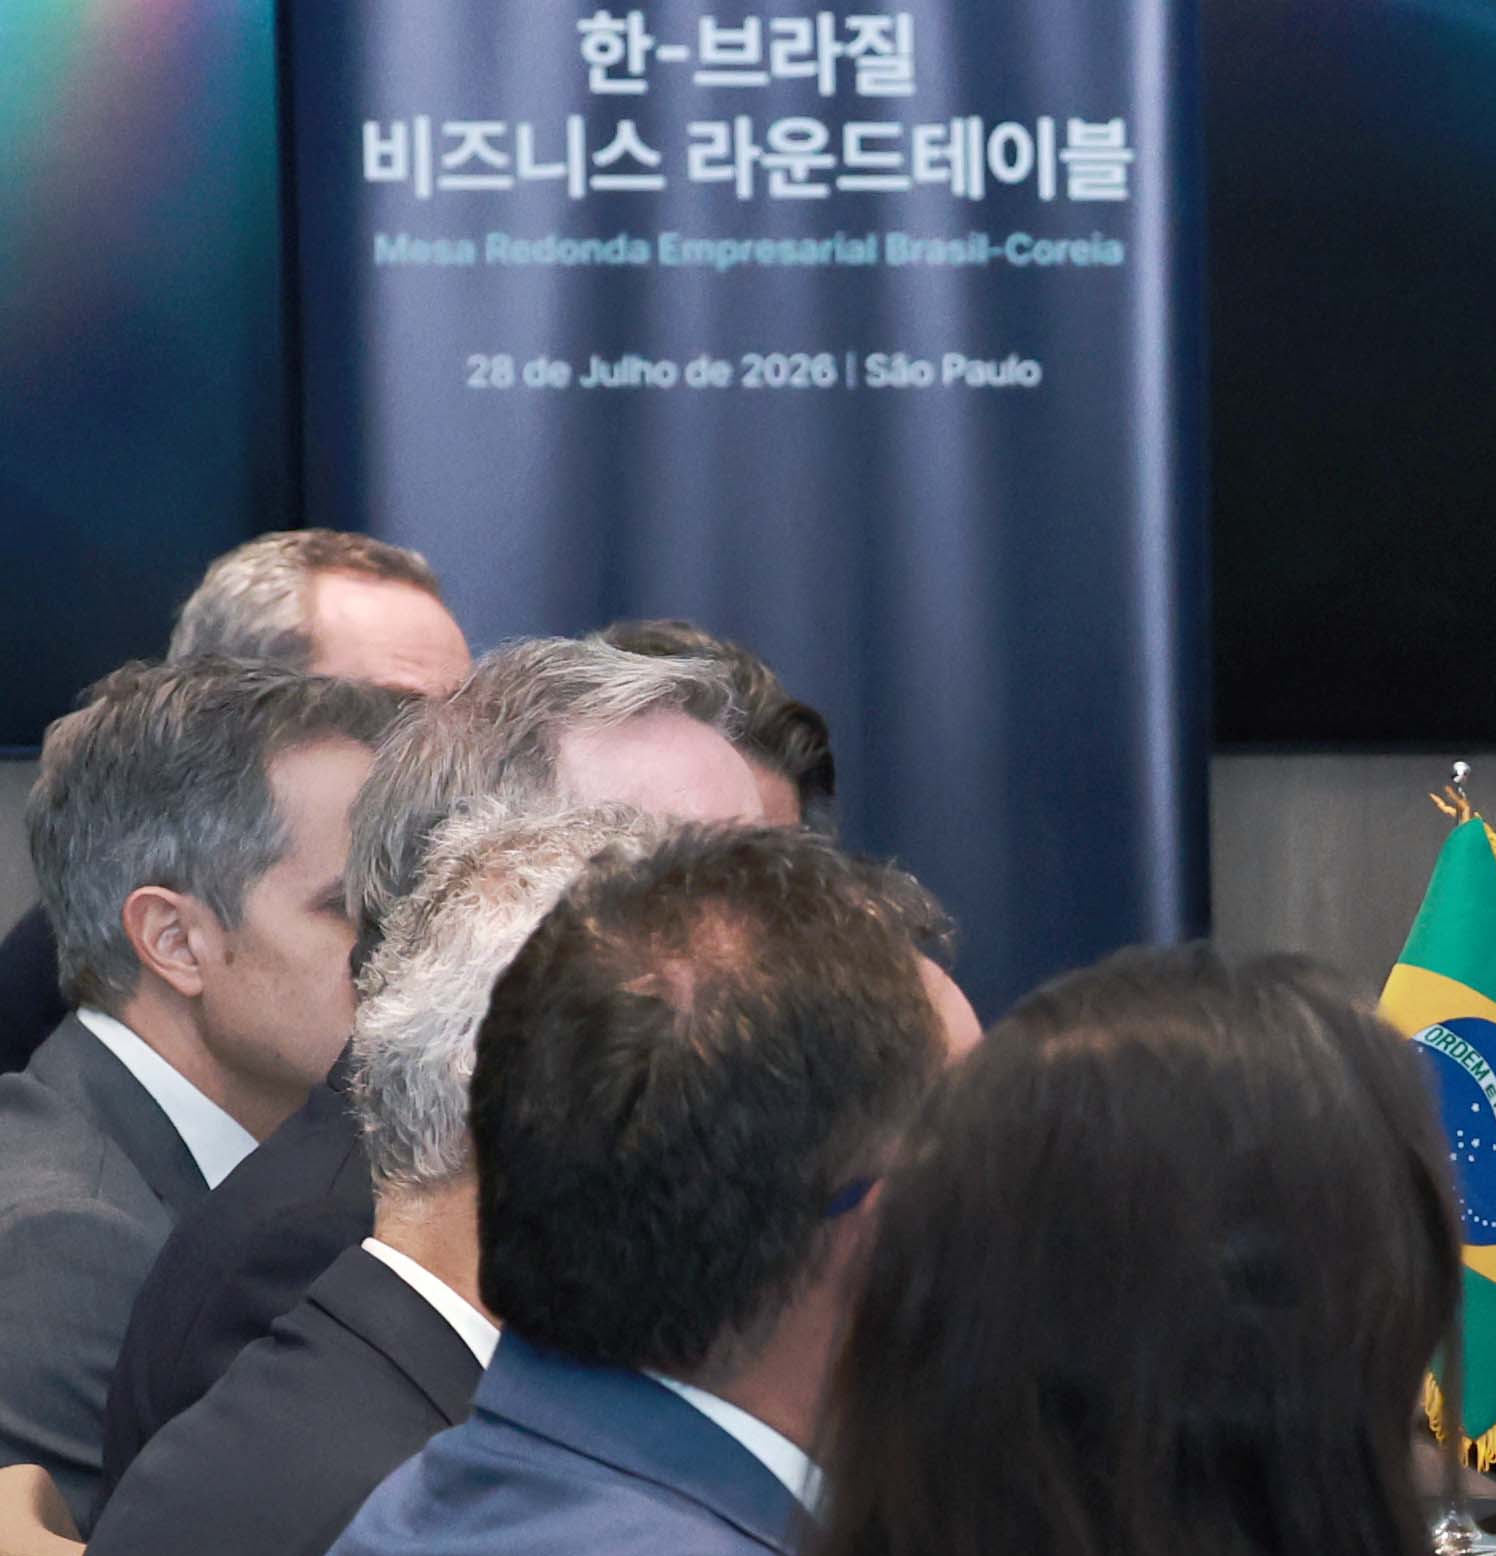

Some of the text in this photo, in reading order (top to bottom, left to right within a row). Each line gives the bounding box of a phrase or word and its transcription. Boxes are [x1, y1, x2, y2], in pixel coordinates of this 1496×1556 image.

[578, 10, 915, 95] 한-브라질
[363, 114, 1134, 200] 비즈니스 라운드테이블
[373, 232, 1124, 271] Mesa Redonda Empresarial Brasil-Coreia
[466, 354, 514, 388] 28
[522, 356, 571, 388] de
[580, 354, 678, 388] Julho
[685, 355, 733, 388] de
[741, 353, 837, 388] 2026
[865, 353, 934, 388] São
[942, 353, 1042, 388] Paulo
[1424, 1026, 1490, 1081] ORDEM
